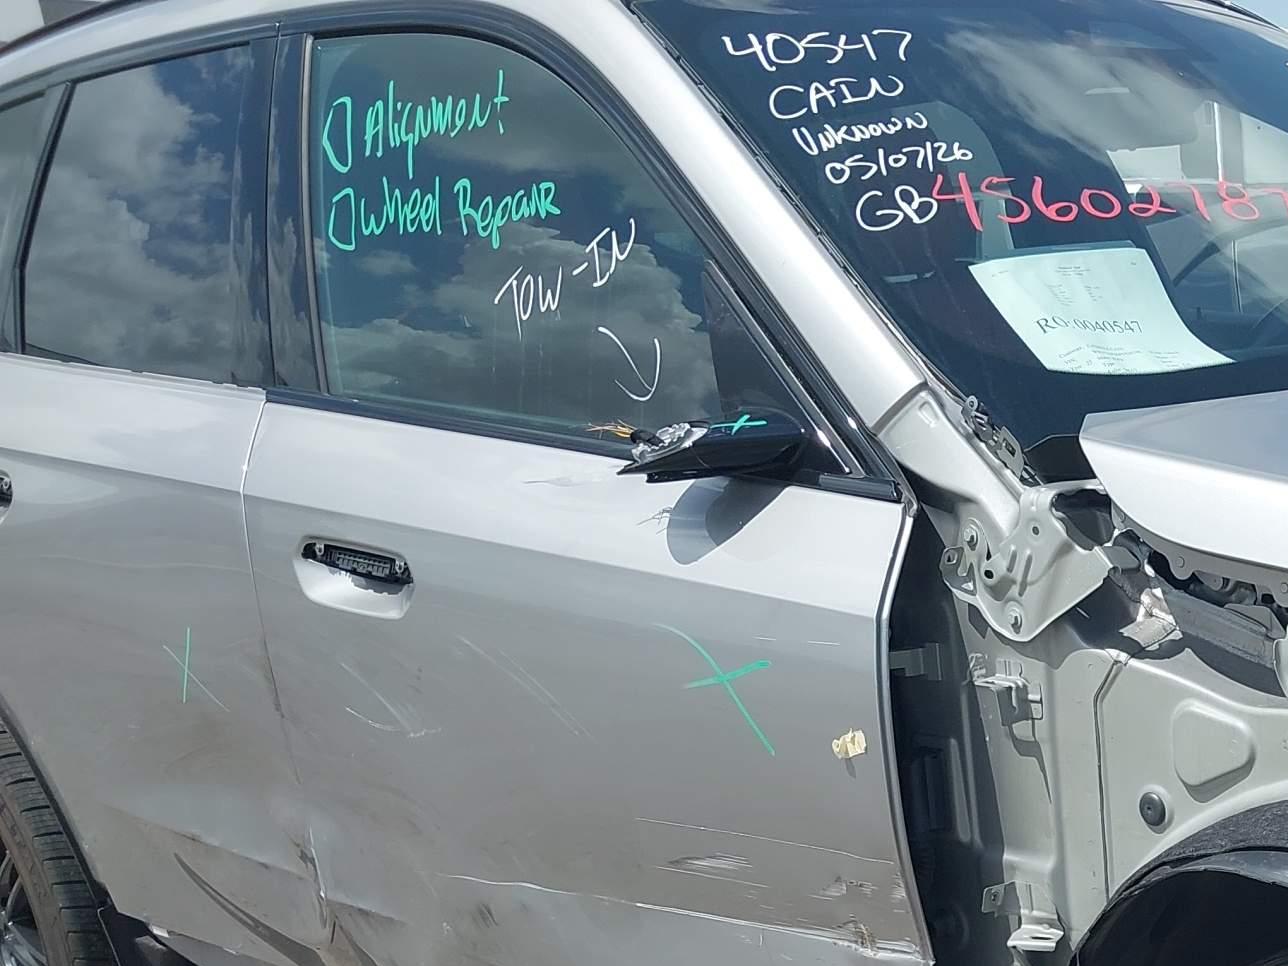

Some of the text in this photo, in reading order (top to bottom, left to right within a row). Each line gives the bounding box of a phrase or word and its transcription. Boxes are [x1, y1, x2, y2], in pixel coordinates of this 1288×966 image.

[722, 29, 914, 73] 40547
[768, 75, 905, 120] CAIN
[824, 140, 974, 186] 05/07/26
[855, 184, 939, 232] GB
[1035, 315, 1144, 334] RO:0040547
